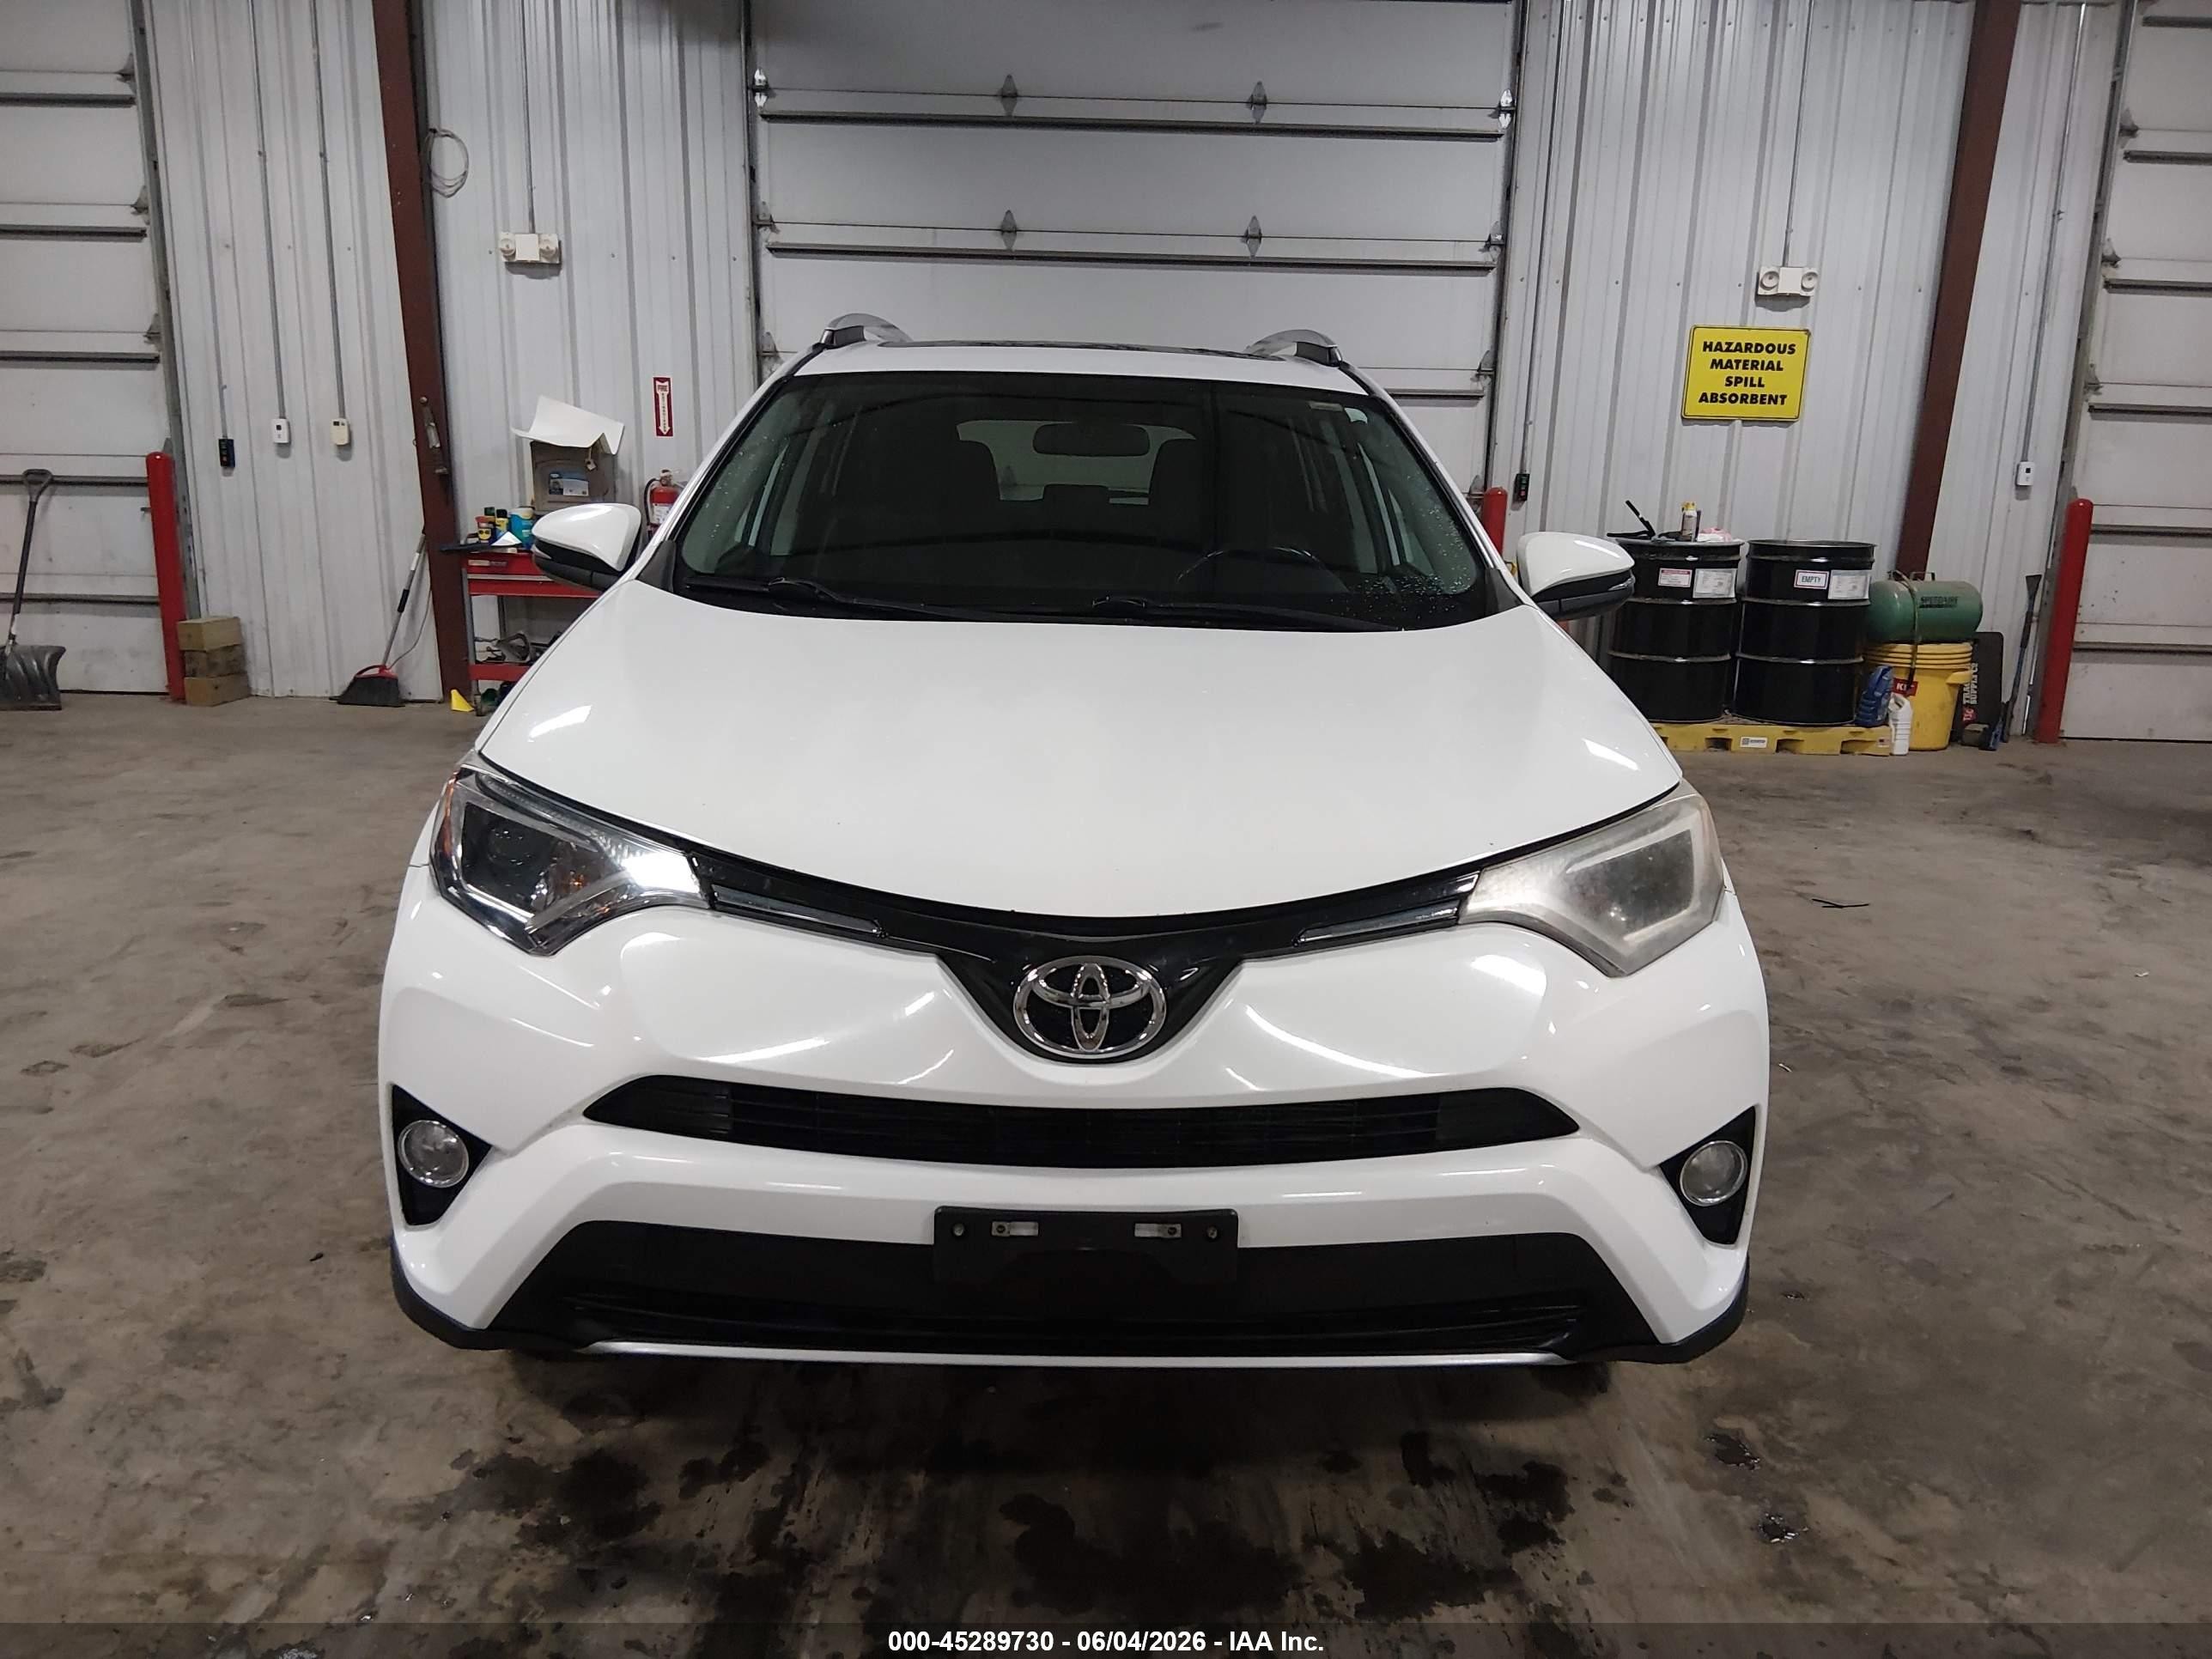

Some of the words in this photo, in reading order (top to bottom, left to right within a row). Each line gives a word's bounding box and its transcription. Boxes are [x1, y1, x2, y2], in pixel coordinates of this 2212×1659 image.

[1702, 341, 1796, 355] HAZARDOUS
[1710, 358, 1784, 371] MATERIAL
[1724, 375, 1765, 388] SPILL
[1698, 392, 1788, 405] ABSORBENT
[1801, 575, 1821, 584] EMPTY
[1896, 683, 1915, 691] KI
